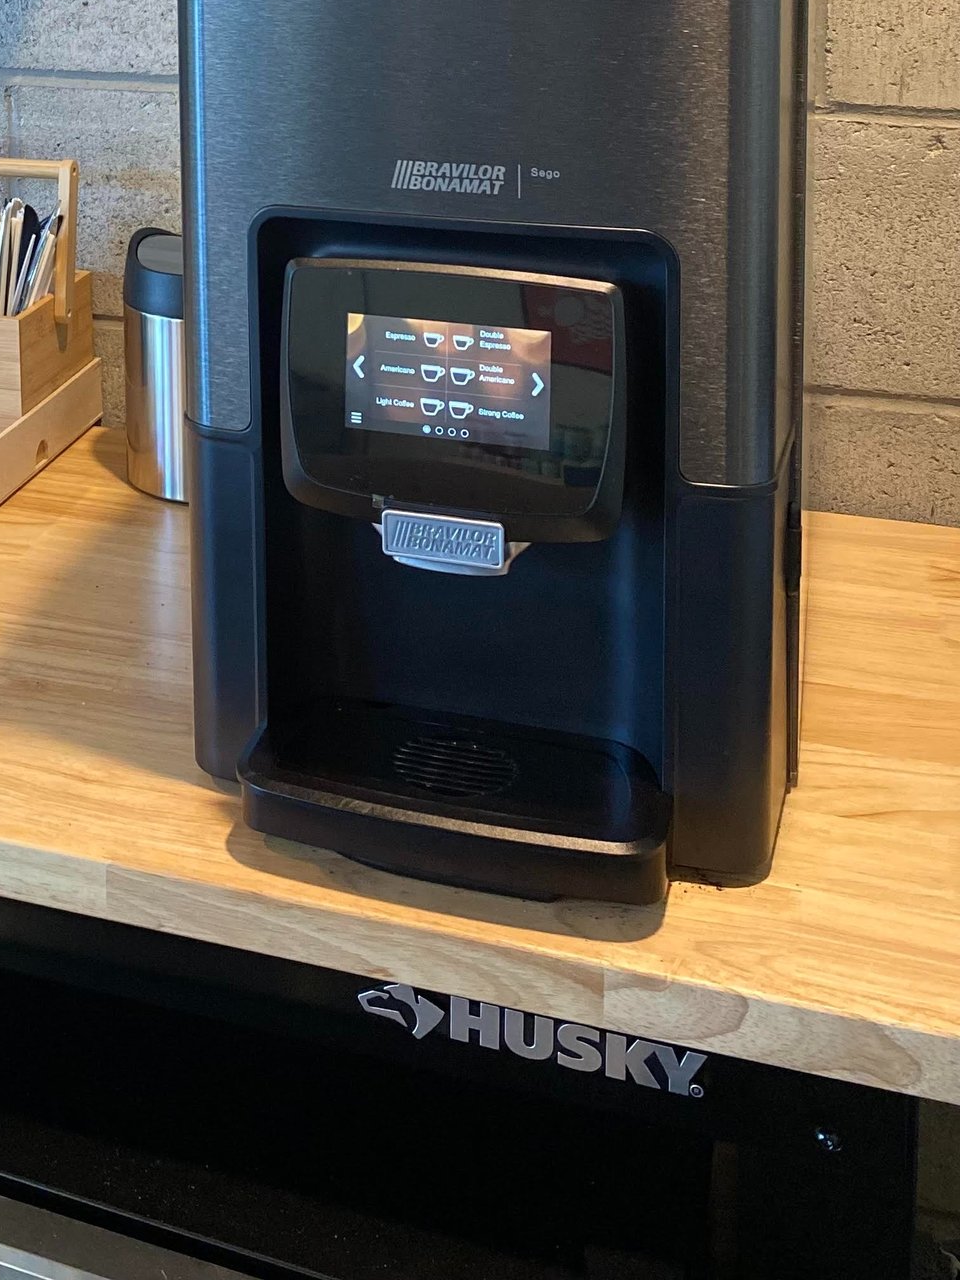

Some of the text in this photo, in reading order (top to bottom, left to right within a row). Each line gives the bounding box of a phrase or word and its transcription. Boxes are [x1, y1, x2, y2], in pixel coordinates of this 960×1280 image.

[412, 161, 561, 180] BRAVILOR Sego
[409, 176, 505, 195] BONAMAT
[385, 331, 417, 342] Espresso
[479, 330, 505, 340] Double
[479, 340, 512, 351] Espresso
[380, 364, 416, 375] Americano
[478, 364, 504, 374] Double
[478, 374, 515, 385] Americano
[376, 396, 415, 408] Light Coffee
[478, 408, 525, 420] Strong Coffee
[413, 522, 497, 546] BRAVILOR
[409, 536, 496, 560] BONAMAT
[449, 994, 708, 1096] HUSKY
